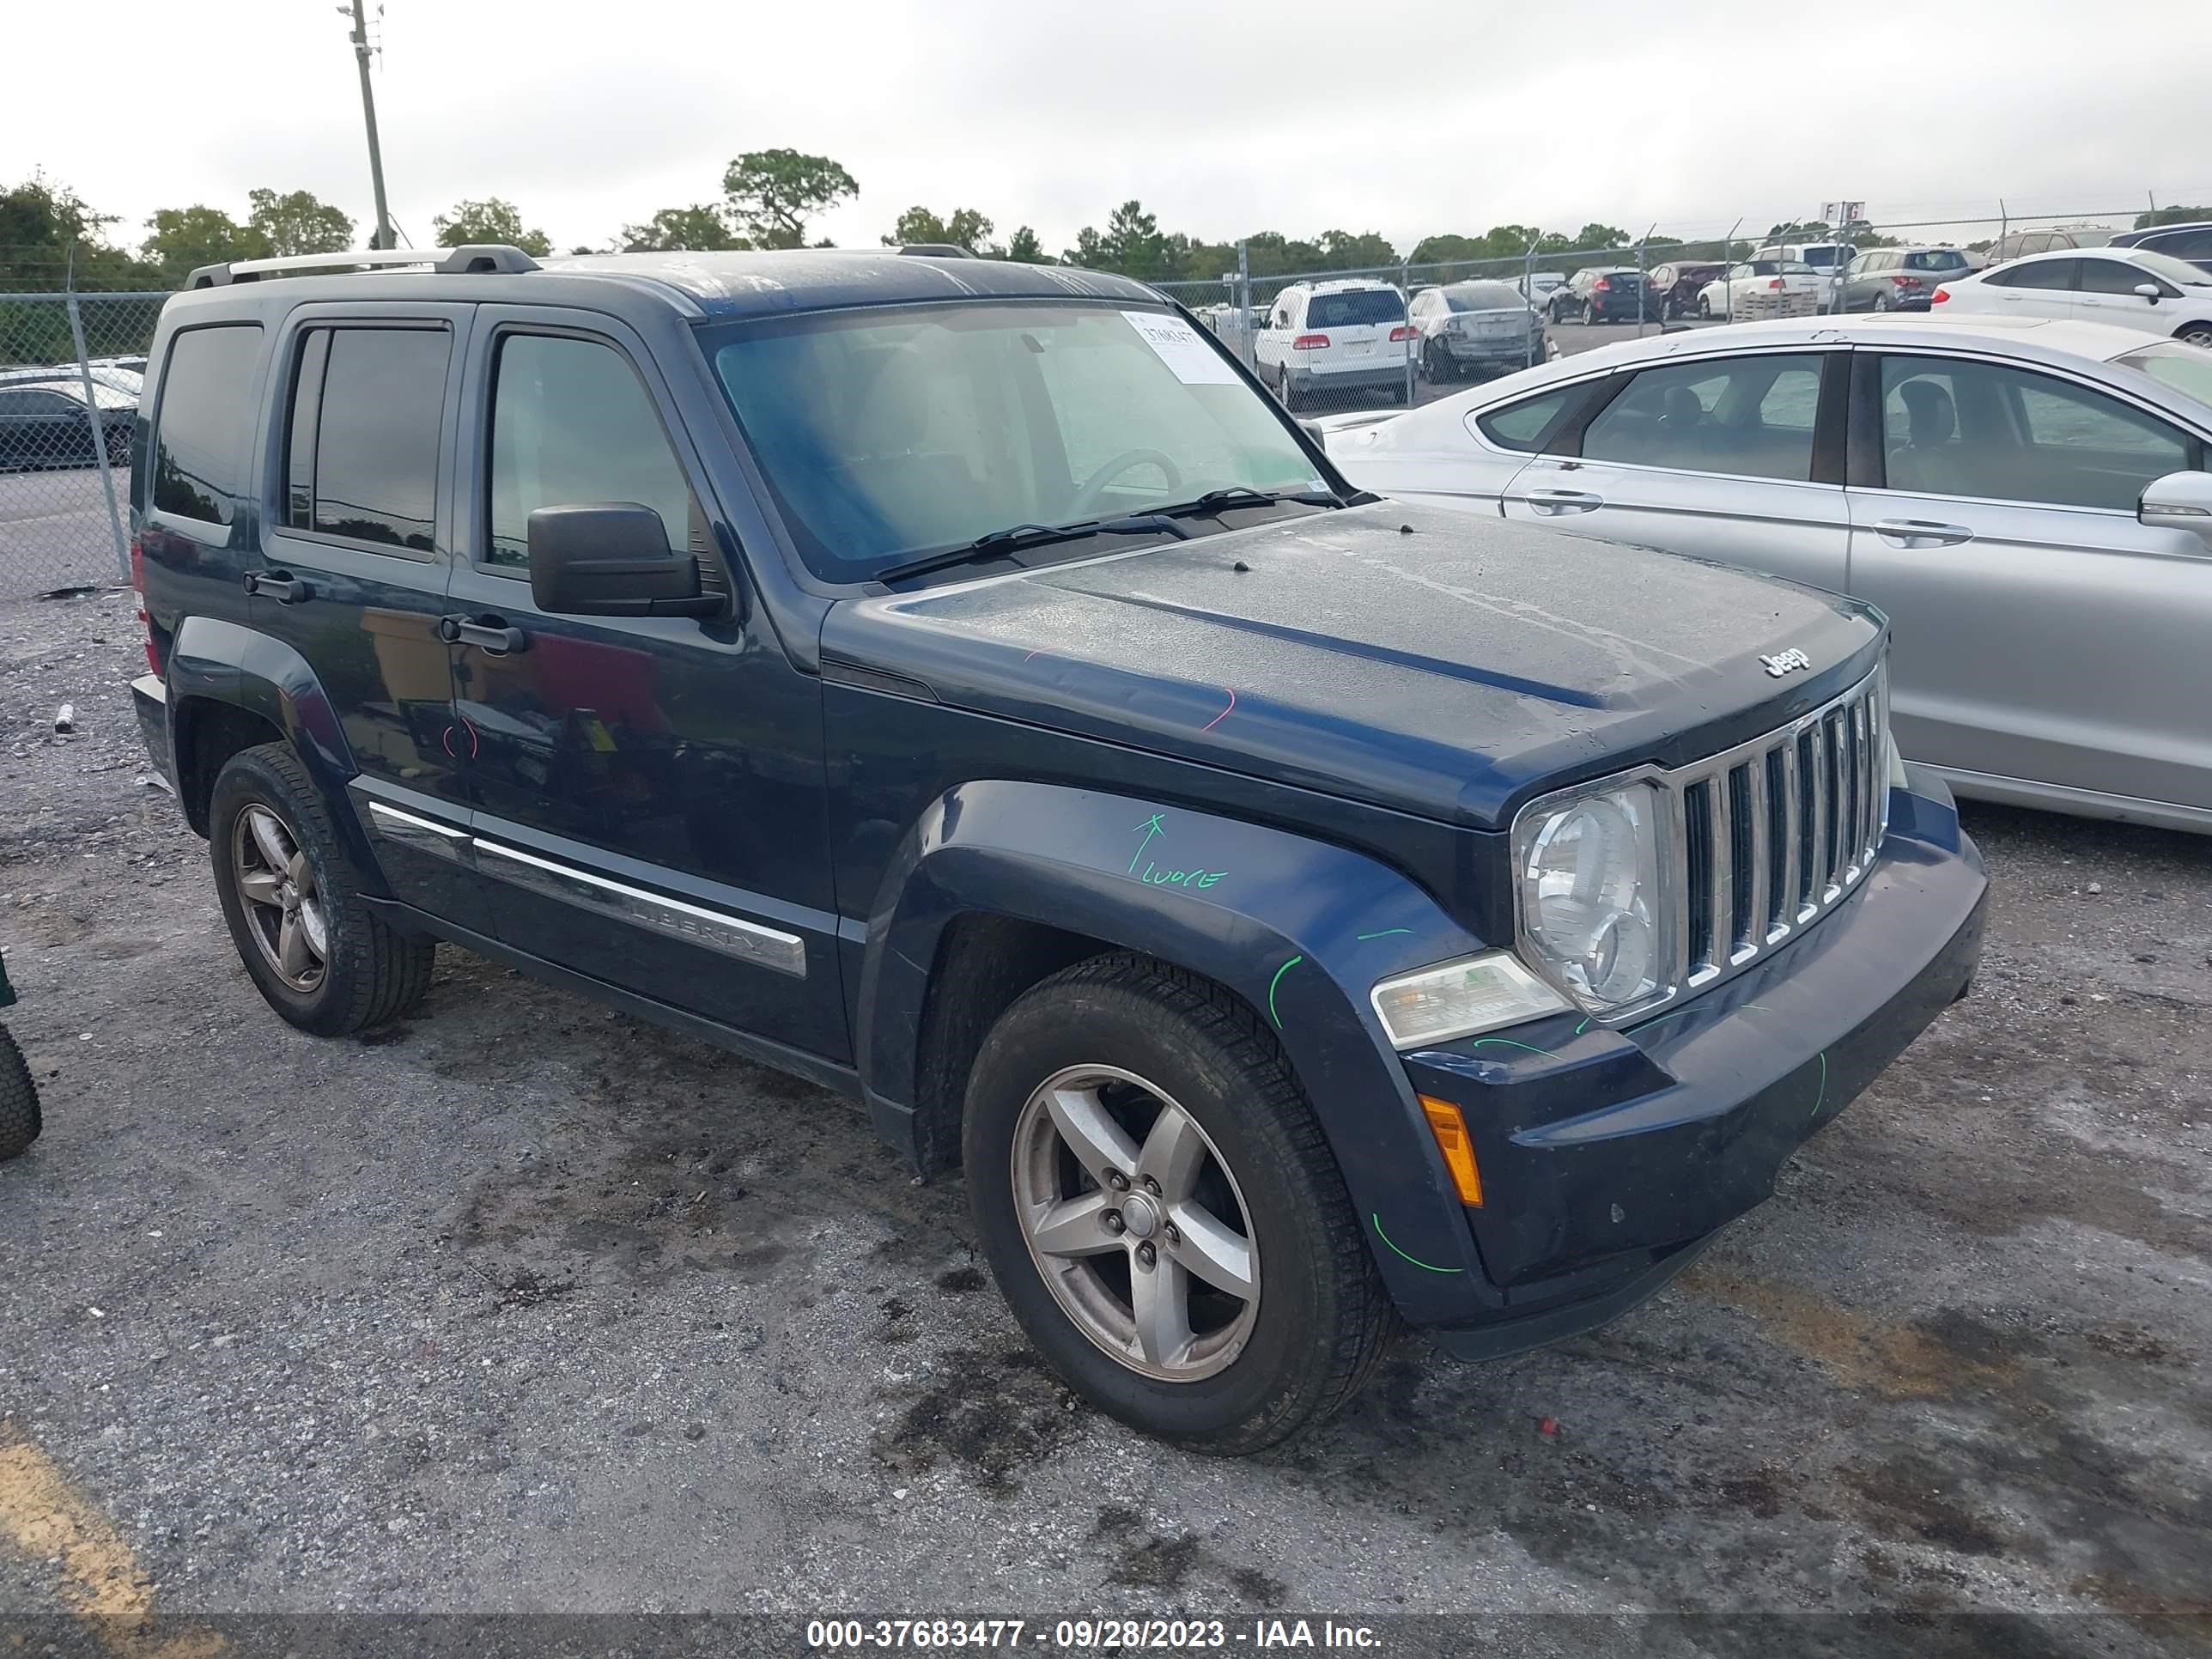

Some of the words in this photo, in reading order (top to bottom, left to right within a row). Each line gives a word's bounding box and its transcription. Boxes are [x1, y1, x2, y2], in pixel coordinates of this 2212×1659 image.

[1826, 204, 1834, 221] F
[1850, 204, 1859, 220] G
[1759, 647, 1810, 678] Jeep
